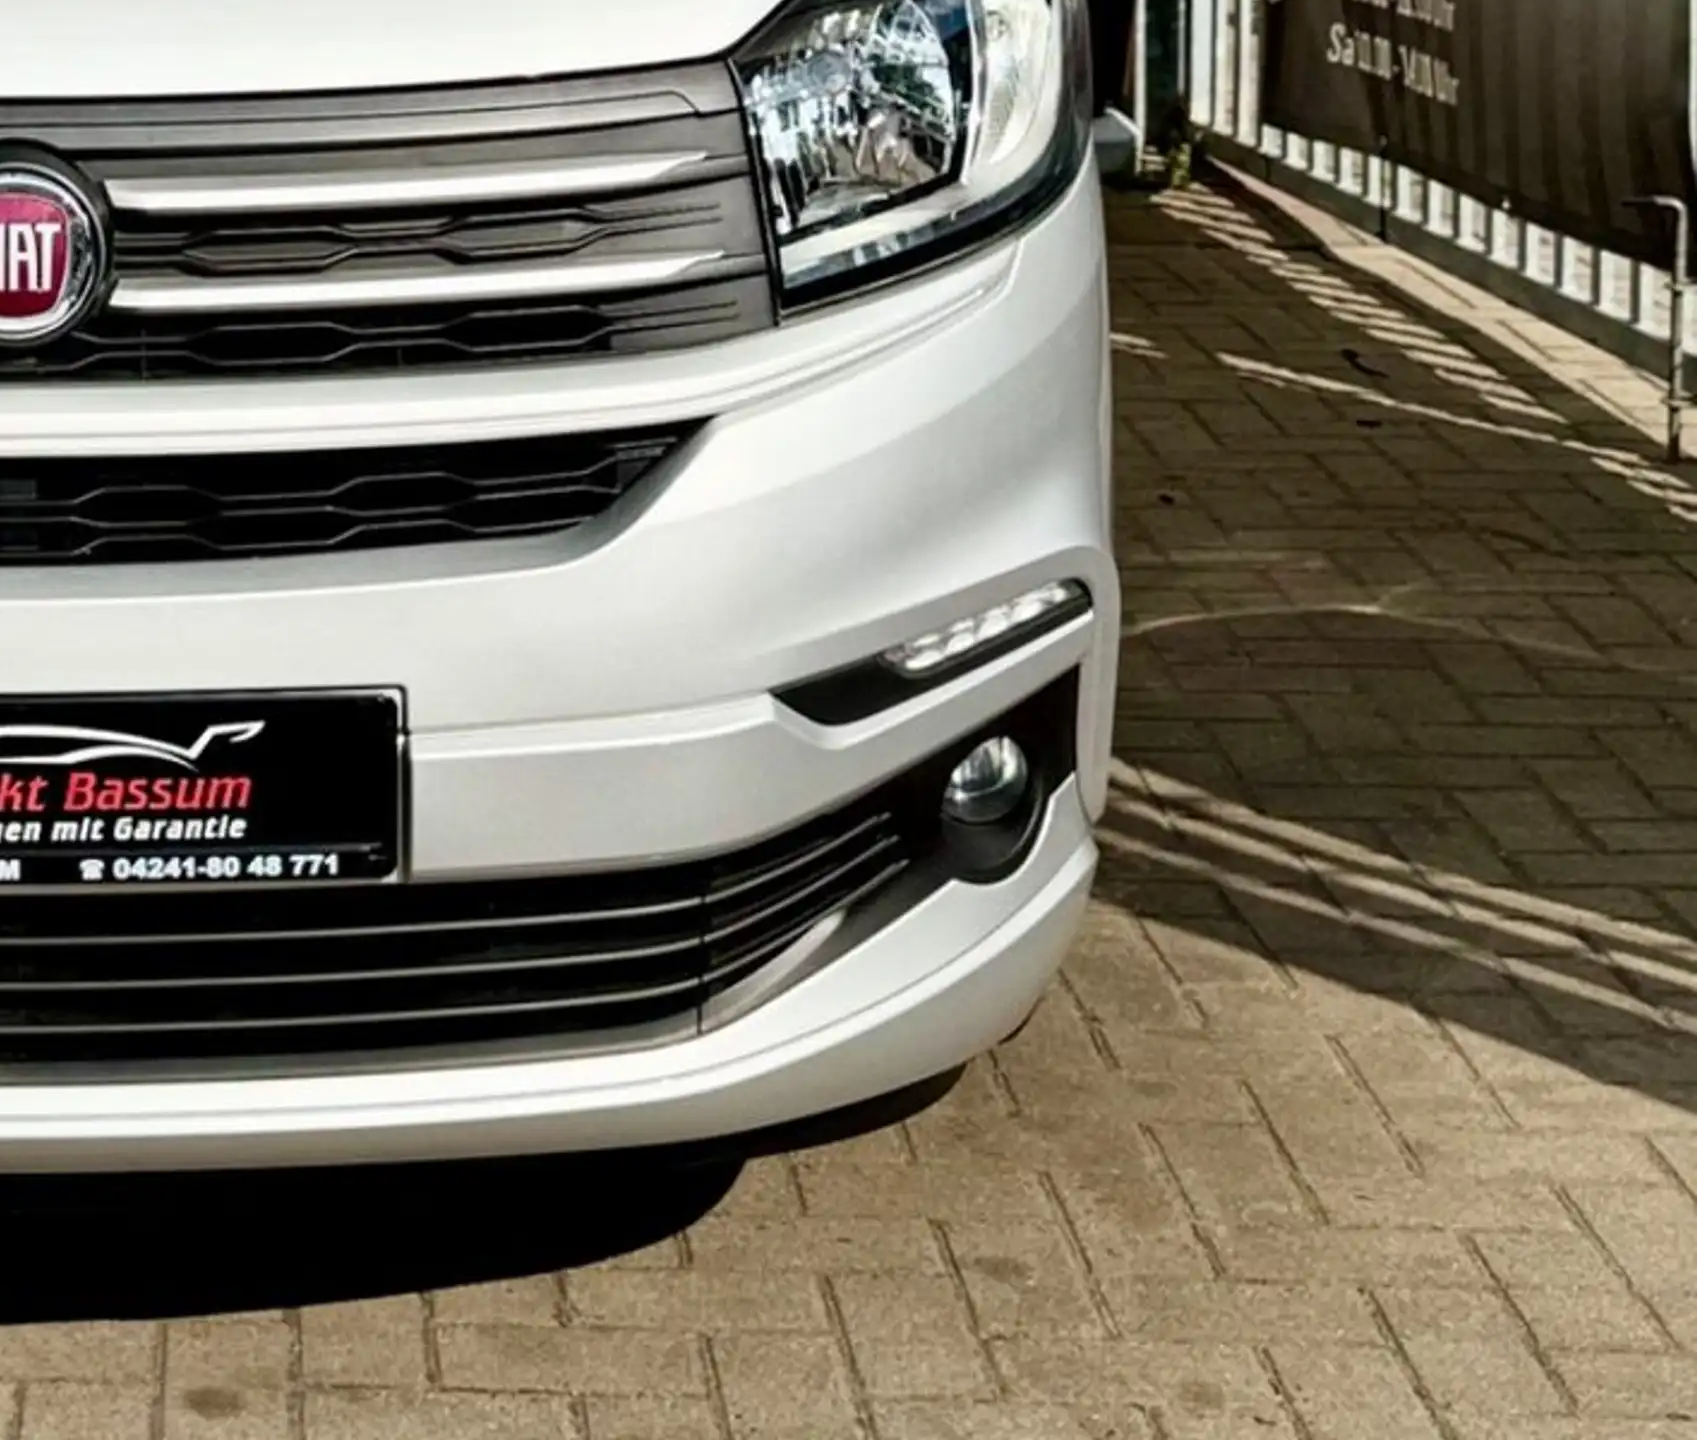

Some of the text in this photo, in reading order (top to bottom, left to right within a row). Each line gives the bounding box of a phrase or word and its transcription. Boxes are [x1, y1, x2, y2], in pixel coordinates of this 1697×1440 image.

[1327, 22, 1354, 66] Sa
[64, 771, 251, 811] Bassum
[51, 817, 104, 842] mit
[113, 814, 247, 841] Garantie
[112, 856, 240, 880] 04241-80
[247, 855, 283, 878] 48
[289, 853, 340, 876] 771
